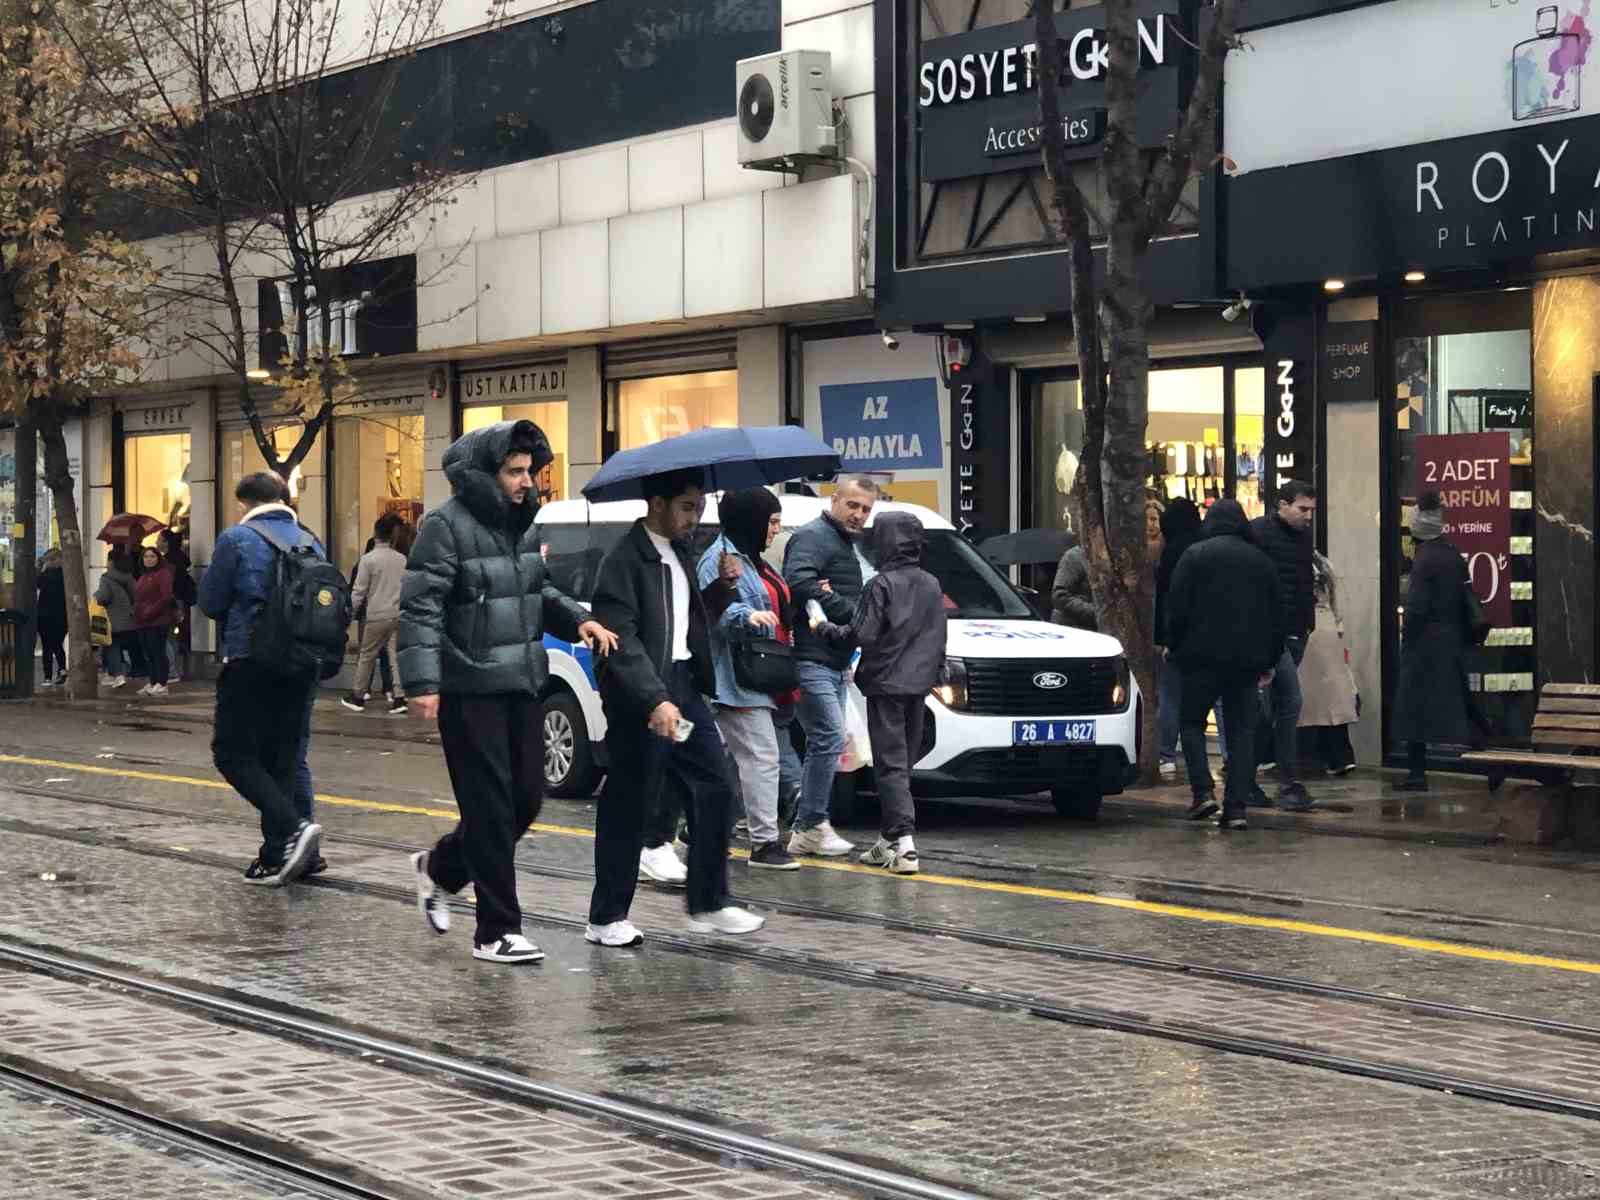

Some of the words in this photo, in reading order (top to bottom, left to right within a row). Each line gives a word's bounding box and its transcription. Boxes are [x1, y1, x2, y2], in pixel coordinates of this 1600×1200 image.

[920, 43, 1037, 107] SOSYET
[985, 116, 1088, 151] Accesies
[499, 370, 566, 394] KATTADI
[1332, 366, 1361, 380] SHOP
[862, 396, 889, 420] AZ
[833, 434, 923, 460] PARAYLA
[1425, 461, 1437, 482] 2
[1442, 458, 1500, 482] ADET
[960, 464, 974, 532] YETE
[1440, 486, 1500, 507] ARFÜM
[1458, 520, 1493, 534] YERİNE
[1022, 723, 1037, 741] 26
[1047, 723, 1055, 740] A
[1064, 723, 1093, 741] 4827
